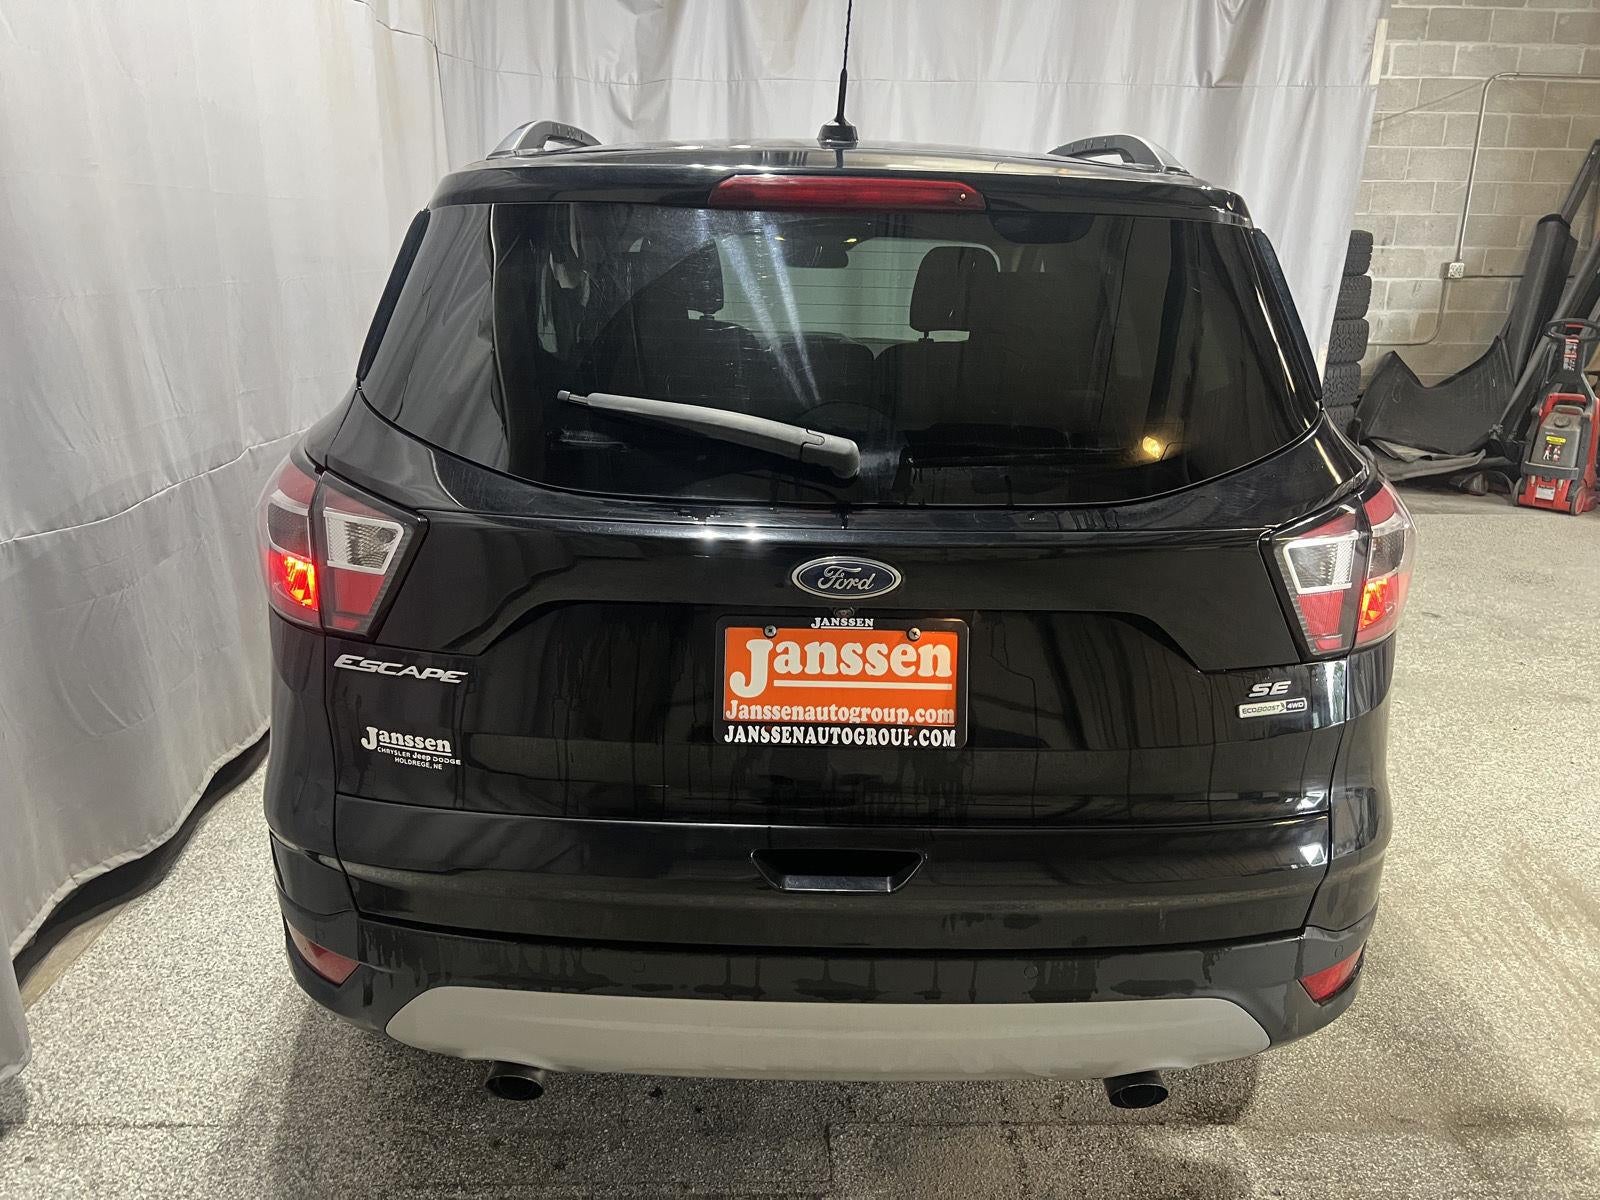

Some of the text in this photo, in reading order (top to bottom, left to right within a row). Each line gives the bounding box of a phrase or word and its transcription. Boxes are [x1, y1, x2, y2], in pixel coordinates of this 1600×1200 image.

[817, 565, 876, 590] Ford
[811, 617, 874, 629] JANSSEN
[333, 653, 469, 684] ESCAPE
[729, 639, 953, 698] Janssen
[1248, 680, 1292, 698] SE
[725, 700, 955, 725] Janssenautogroup.com
[1286, 701, 1304, 709] 4WD
[360, 726, 452, 753] Janssen
[377, 747, 462, 766] CHRYSLER Jeep DODGE
[394, 757, 443, 770] HOLDREGE, NE
